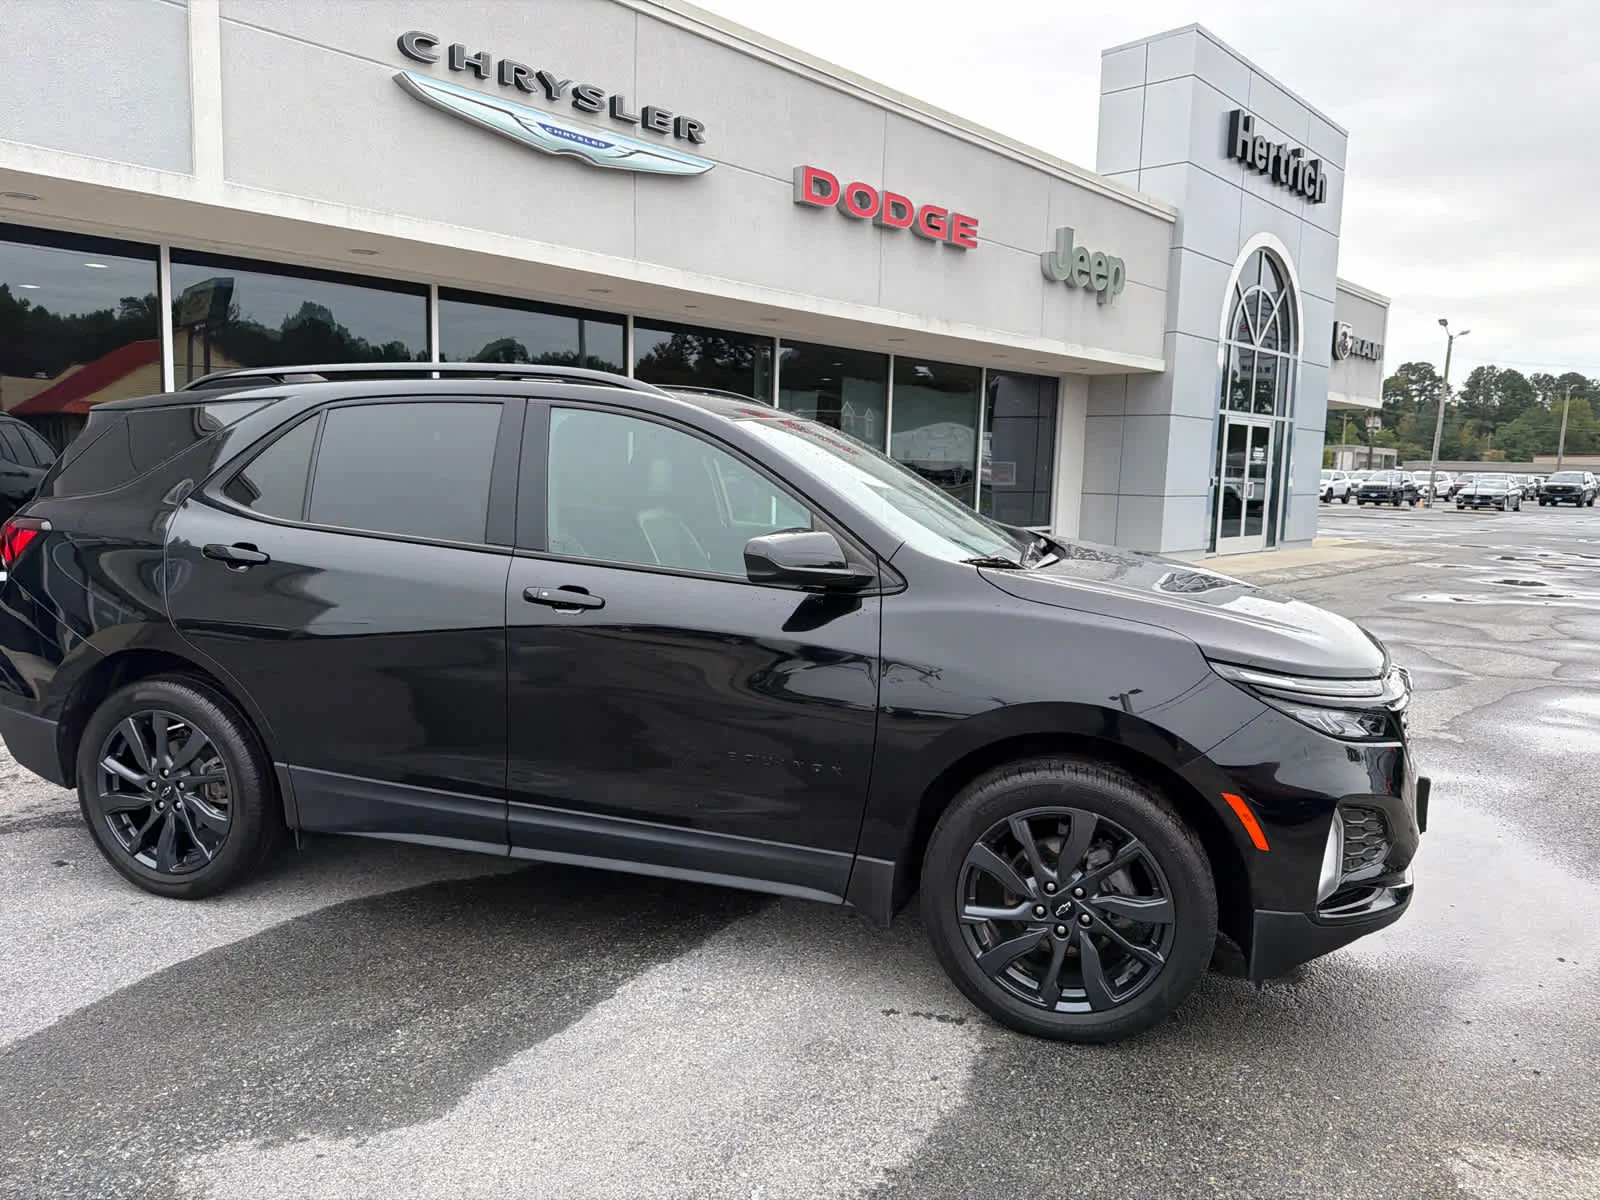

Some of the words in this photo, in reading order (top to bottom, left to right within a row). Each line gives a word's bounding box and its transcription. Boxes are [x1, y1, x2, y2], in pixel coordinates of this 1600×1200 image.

[397, 30, 706, 144] CHRYSLER
[545, 126, 606, 148] CHRYSLER
[1227, 109, 1328, 204] Hertrich
[793, 165, 979, 249] DODGE
[1041, 226, 1126, 306] Jeep
[1349, 335, 1384, 361] RAM
